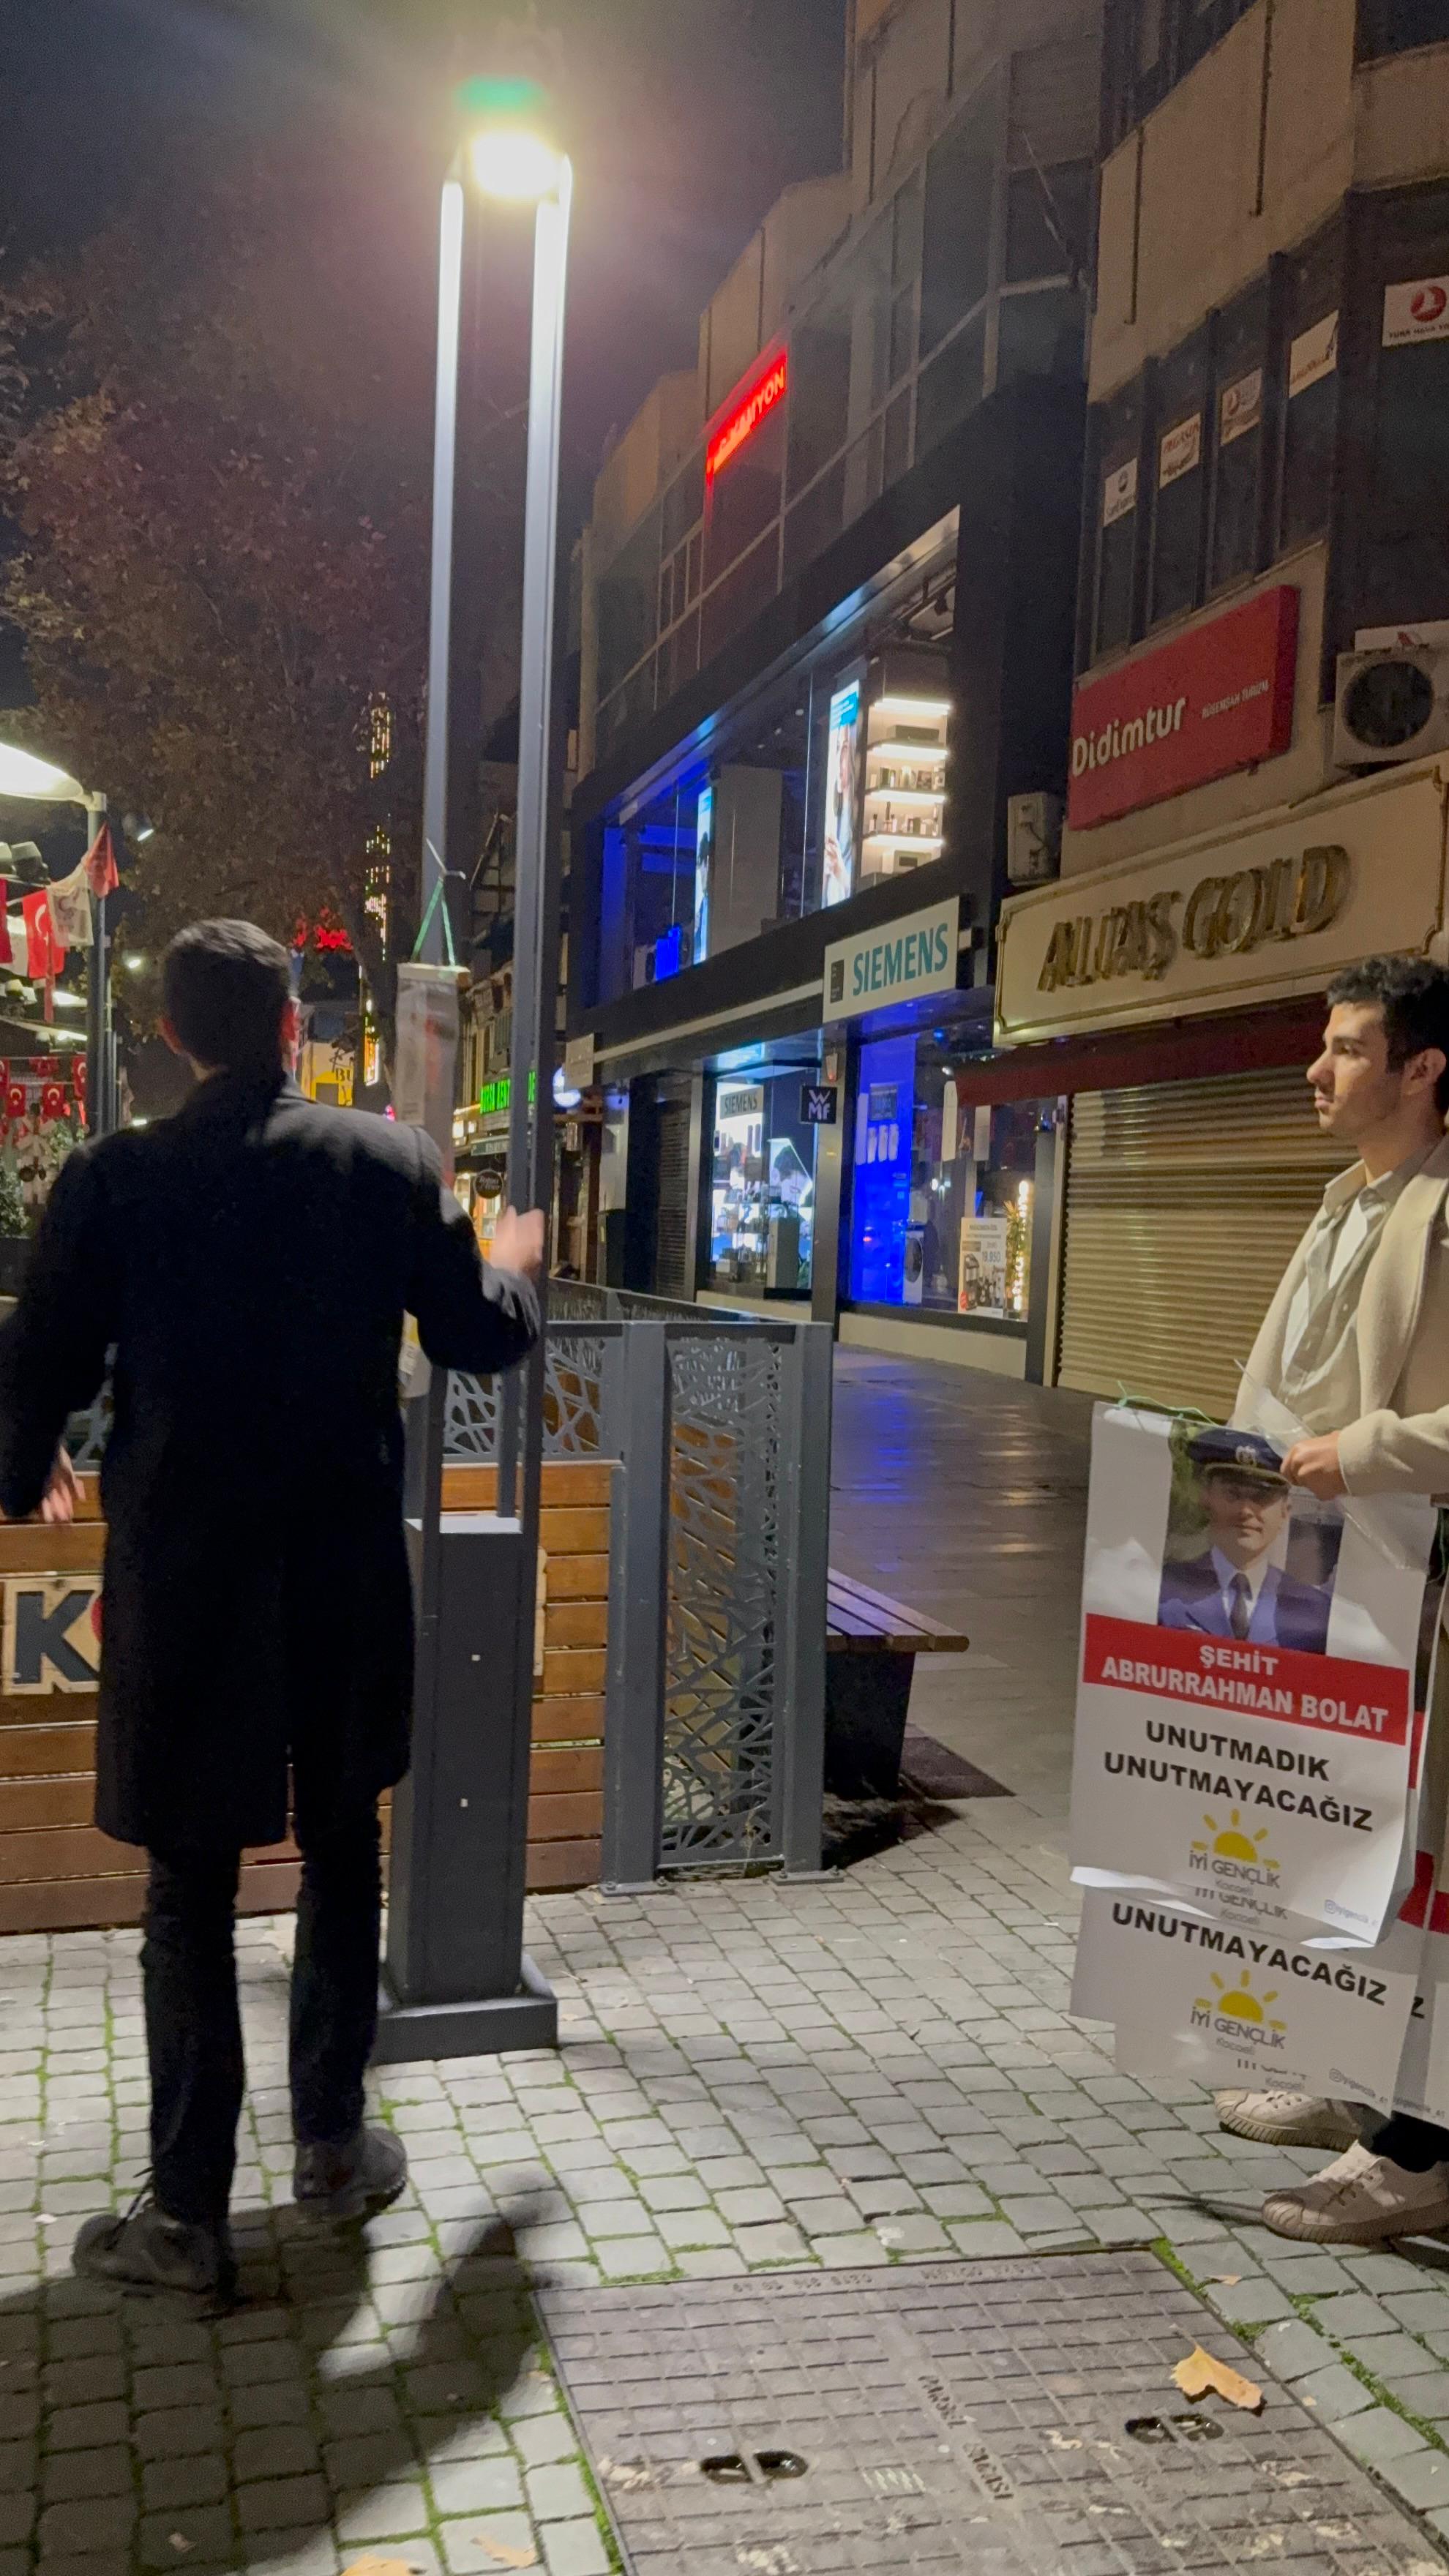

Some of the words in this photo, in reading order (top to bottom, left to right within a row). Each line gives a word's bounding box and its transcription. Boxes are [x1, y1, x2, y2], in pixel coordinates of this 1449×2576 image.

[1072, 697, 1186, 777] Didimtur
[1182, 845, 1349, 959] GOLD
[853, 923, 948, 996] SIEMENS
[724, 1093, 757, 1115] SIEMENS
[1101, 1656, 1293, 1715] ABRURRAHMAN
[1300, 1694, 1389, 1733] BOLAT
[1200, 1644, 1278, 1676] ŞEHİT
[1146, 1720, 1330, 1782] UNUTMADIK
[1104, 1751, 1374, 1832] UNUTMAYACAĞIZ
[1189, 1850, 1208, 1871] İYİ
[1211, 1859, 1281, 1889] GENÇLİK
[1112, 1903, 1388, 2006] UNUTMAYACAĞIZ
[1190, 2006, 1211, 2028] İYİ
[1214, 2018, 1287, 2050] GENÇLİK
